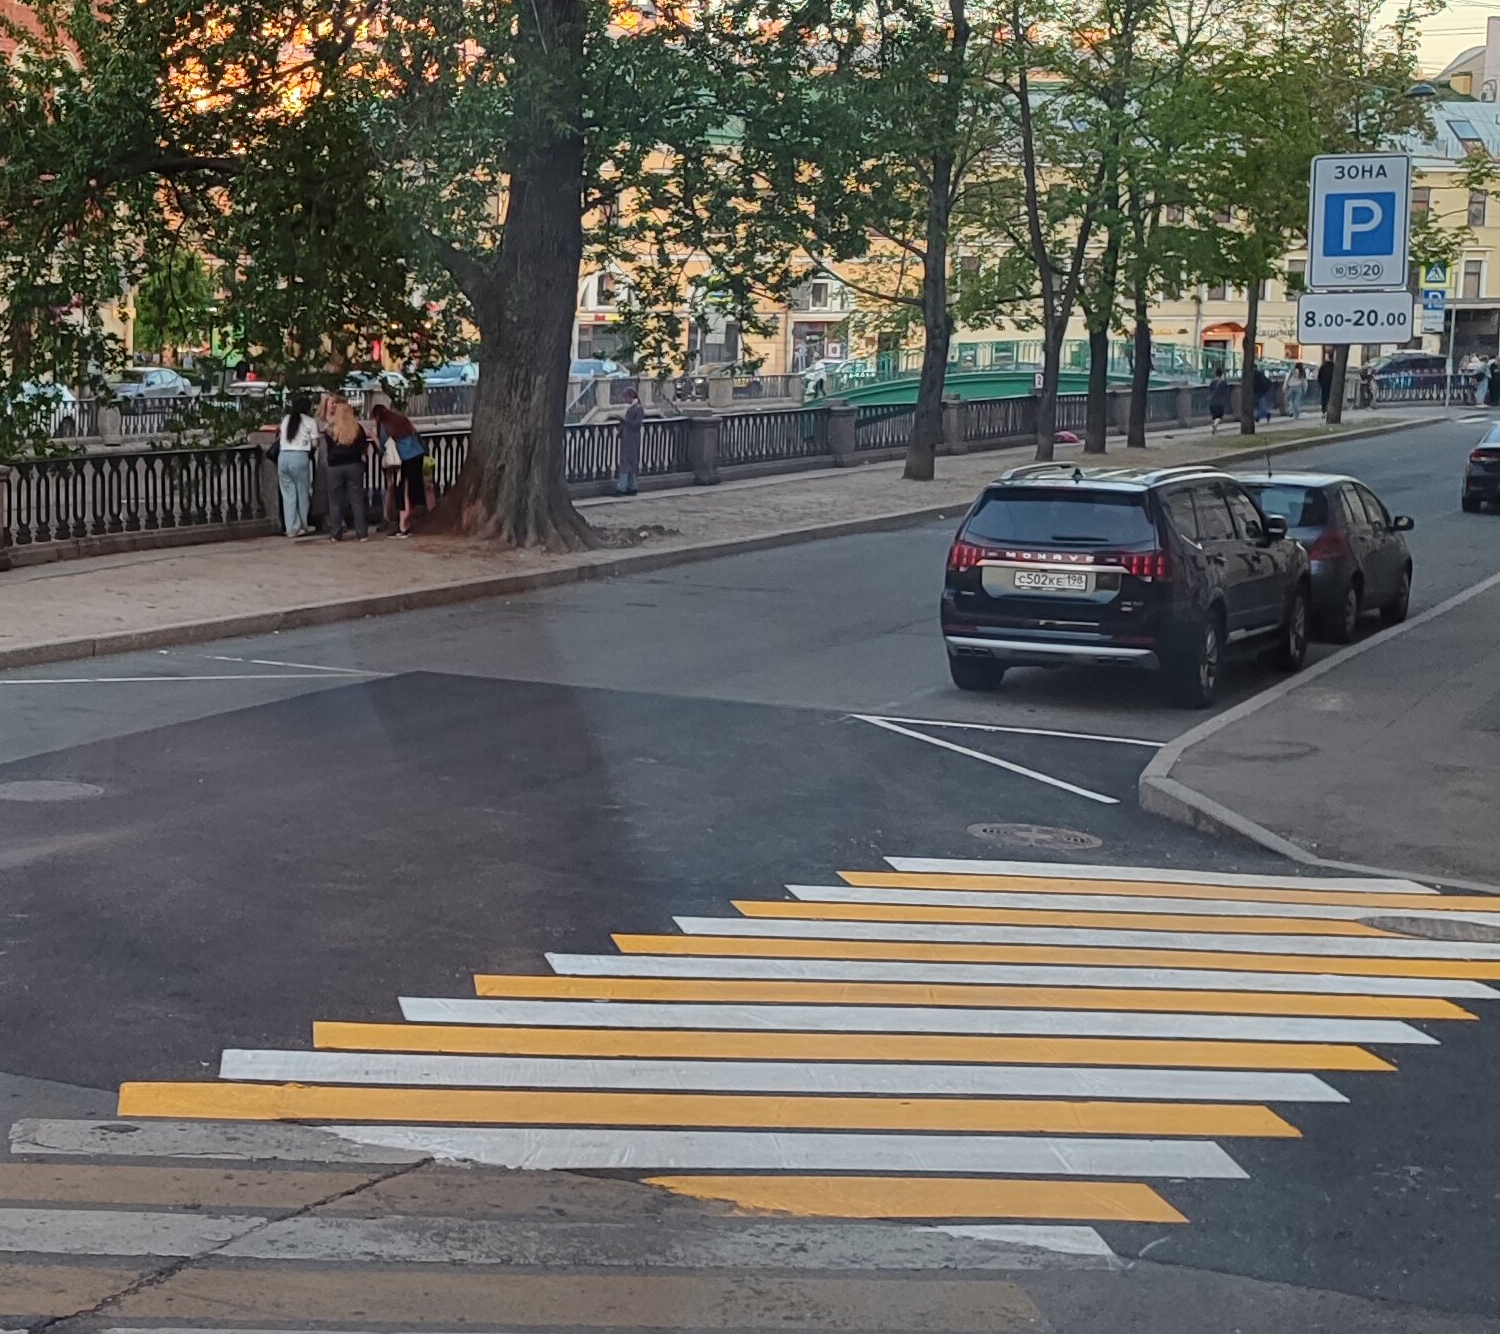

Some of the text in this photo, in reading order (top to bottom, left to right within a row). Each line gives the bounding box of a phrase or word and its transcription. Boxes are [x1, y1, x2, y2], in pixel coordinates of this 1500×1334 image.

[1333, 164, 1388, 180] ЗОНА
[1342, 198, 1383, 251] P
[1335, 264, 1380, 276] 10 15 20
[1304, 309, 1407, 328] 8.00-20.00
